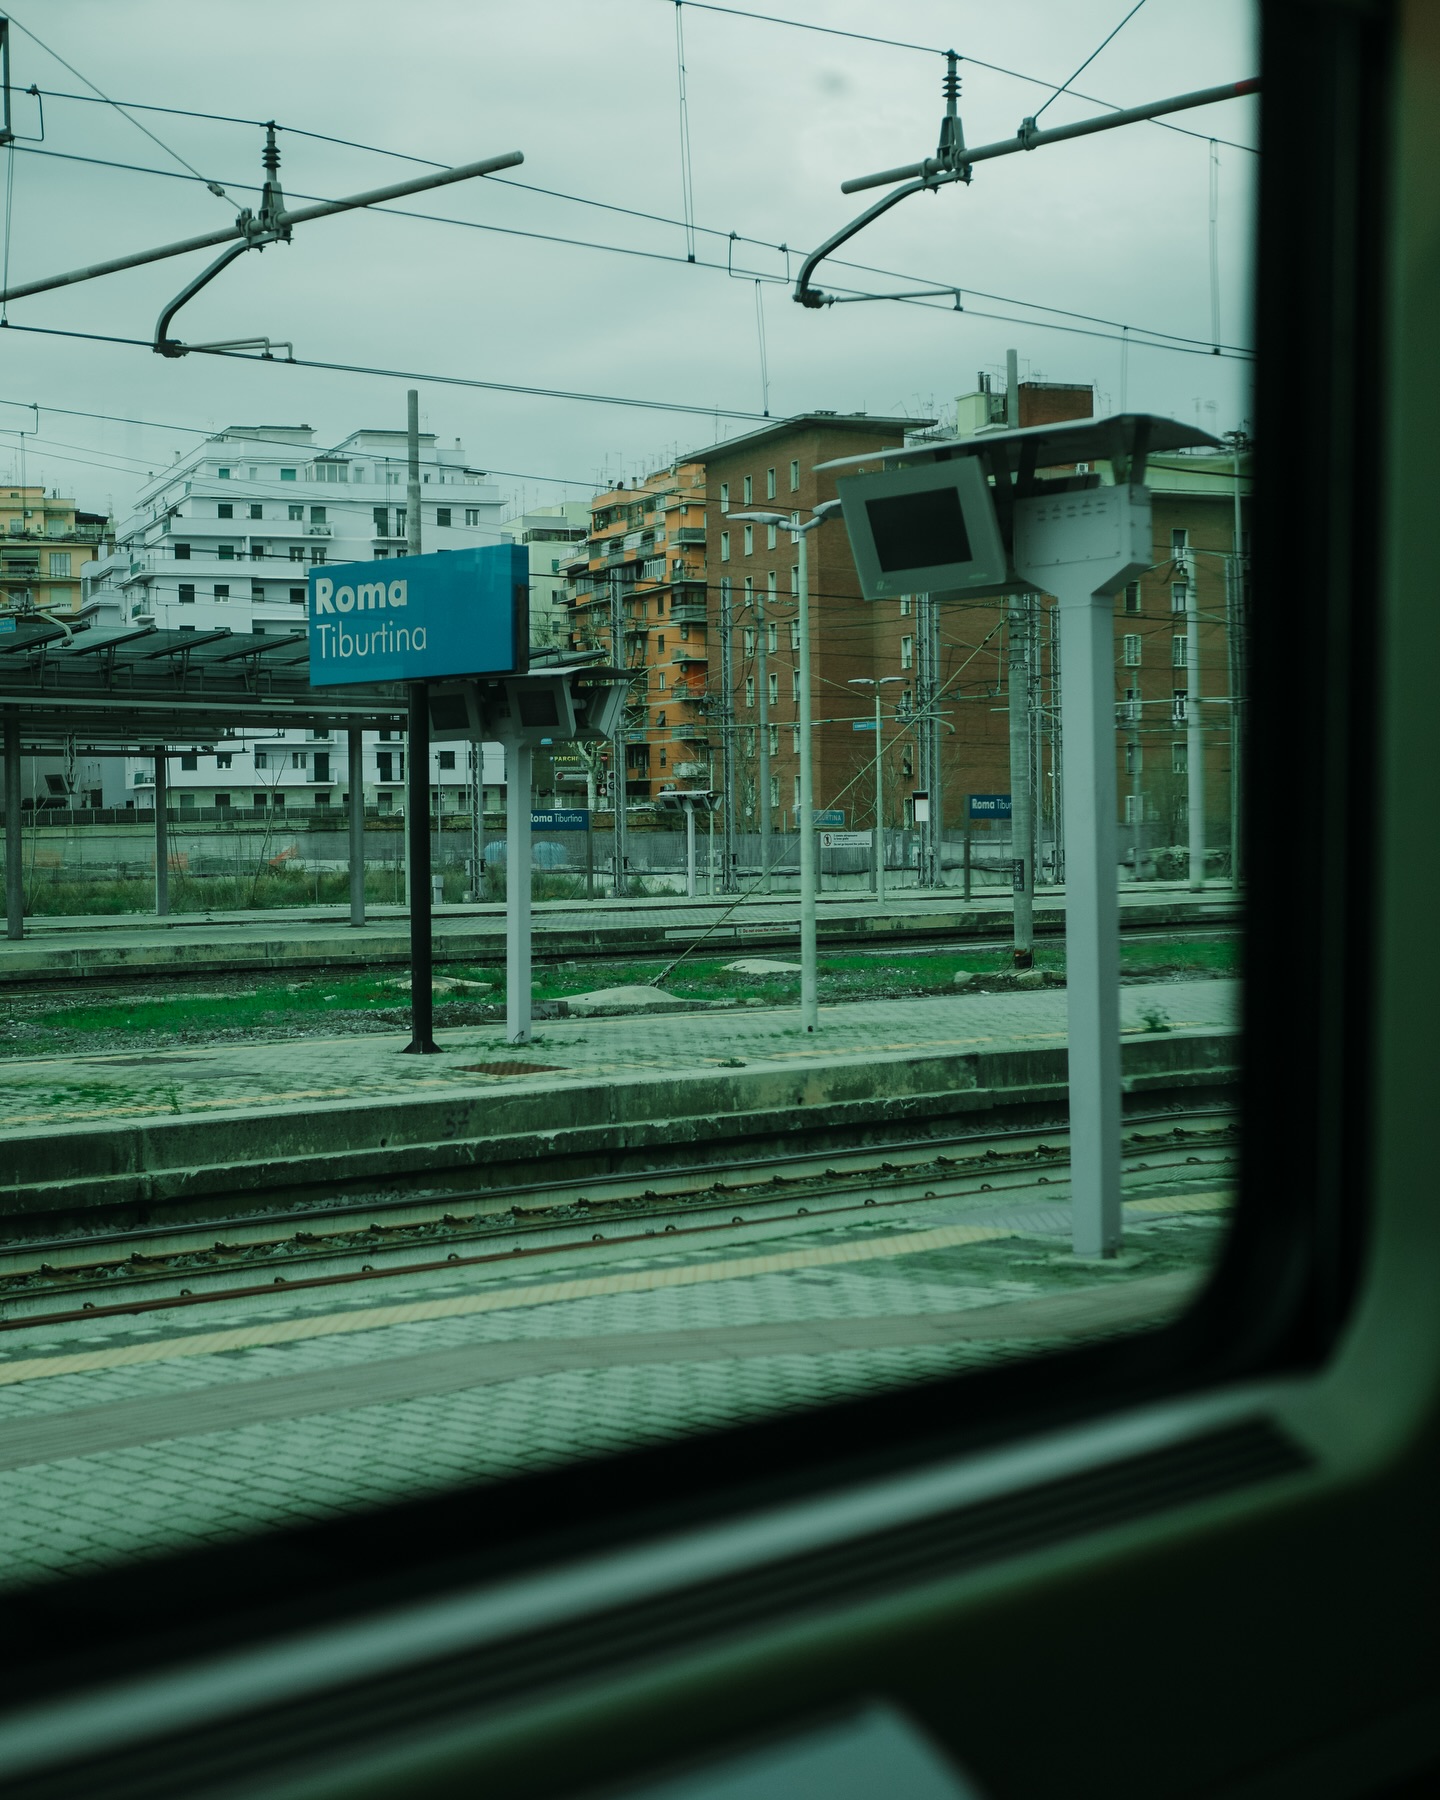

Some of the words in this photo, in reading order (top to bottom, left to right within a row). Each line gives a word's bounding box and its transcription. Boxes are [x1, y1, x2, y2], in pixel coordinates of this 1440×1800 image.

[316, 578, 407, 614] Roma
[316, 620, 427, 659] Tiburtina
[972, 798, 995, 809] Roma
[554, 813, 582, 822] Tiburtina
